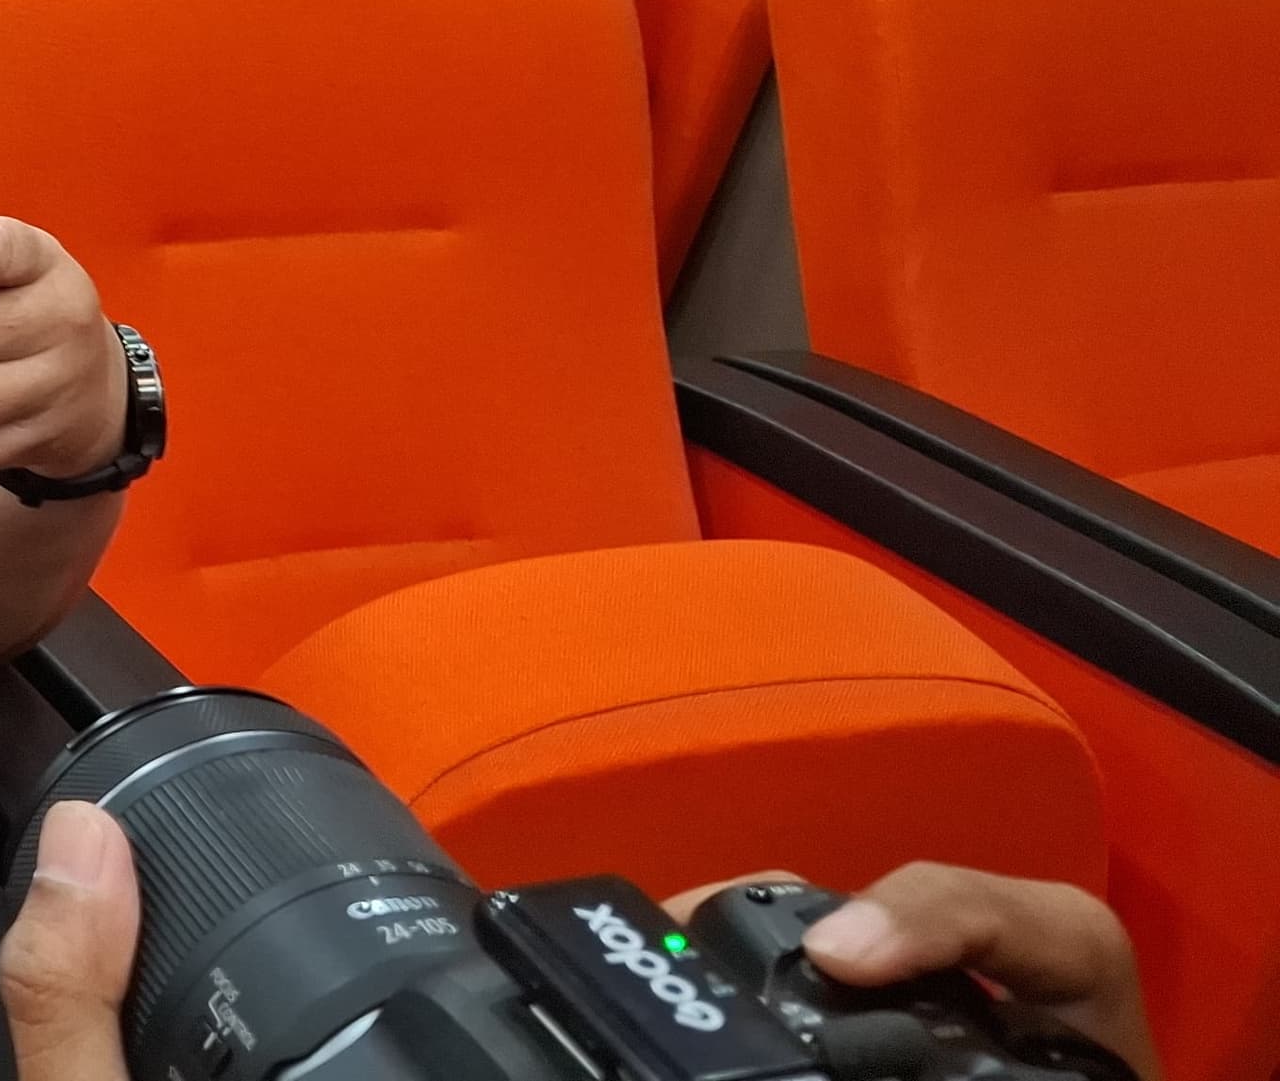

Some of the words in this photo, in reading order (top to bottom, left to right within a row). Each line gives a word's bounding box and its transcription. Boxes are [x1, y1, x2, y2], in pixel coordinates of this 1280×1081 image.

[347, 896, 438, 920] Canon
[376, 917, 458, 945] 24-105
[572, 903, 725, 1032] Godox
